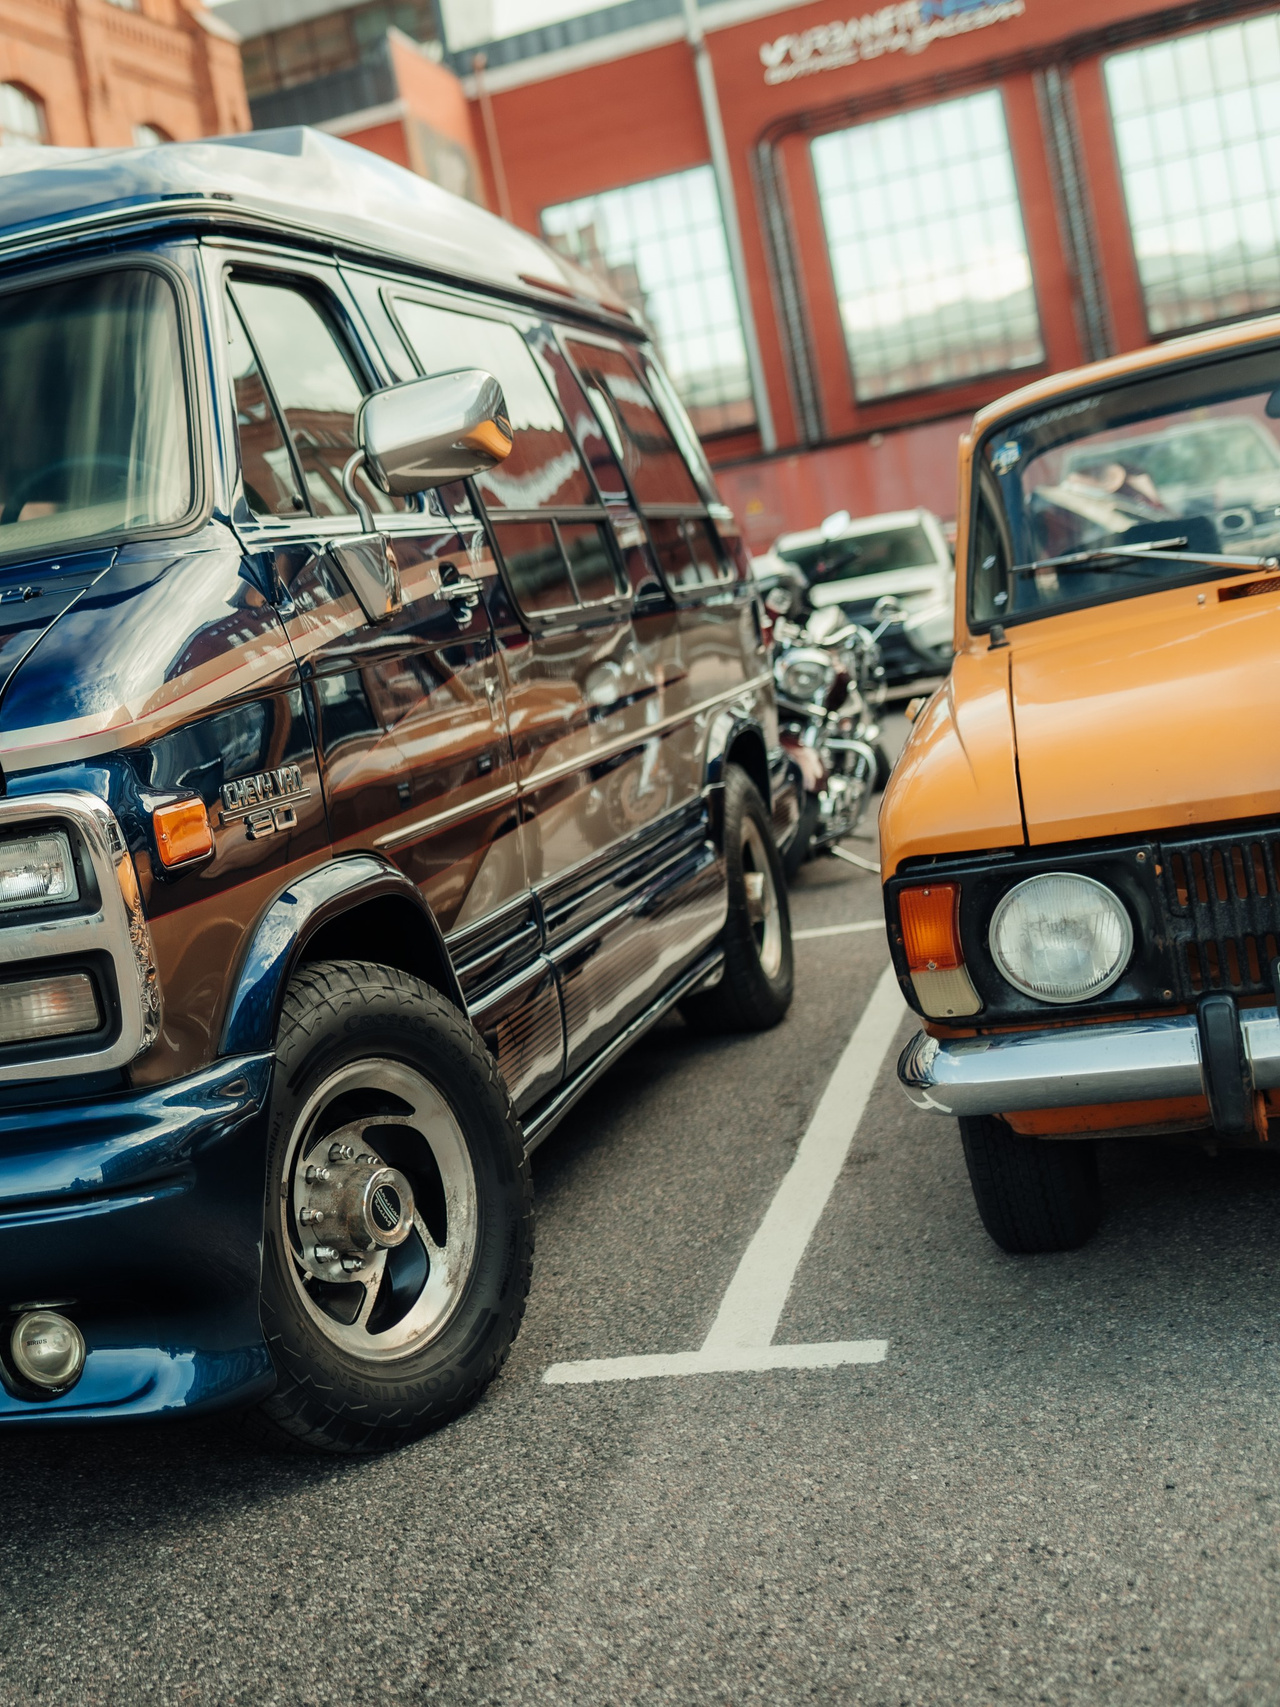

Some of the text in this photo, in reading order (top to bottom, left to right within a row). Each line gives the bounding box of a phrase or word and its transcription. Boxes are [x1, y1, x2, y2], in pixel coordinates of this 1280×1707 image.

[221, 764, 303, 810] CHEVY VAN
[374, 1198, 392, 1227] Racing
[379, 1187, 400, 1220] American
